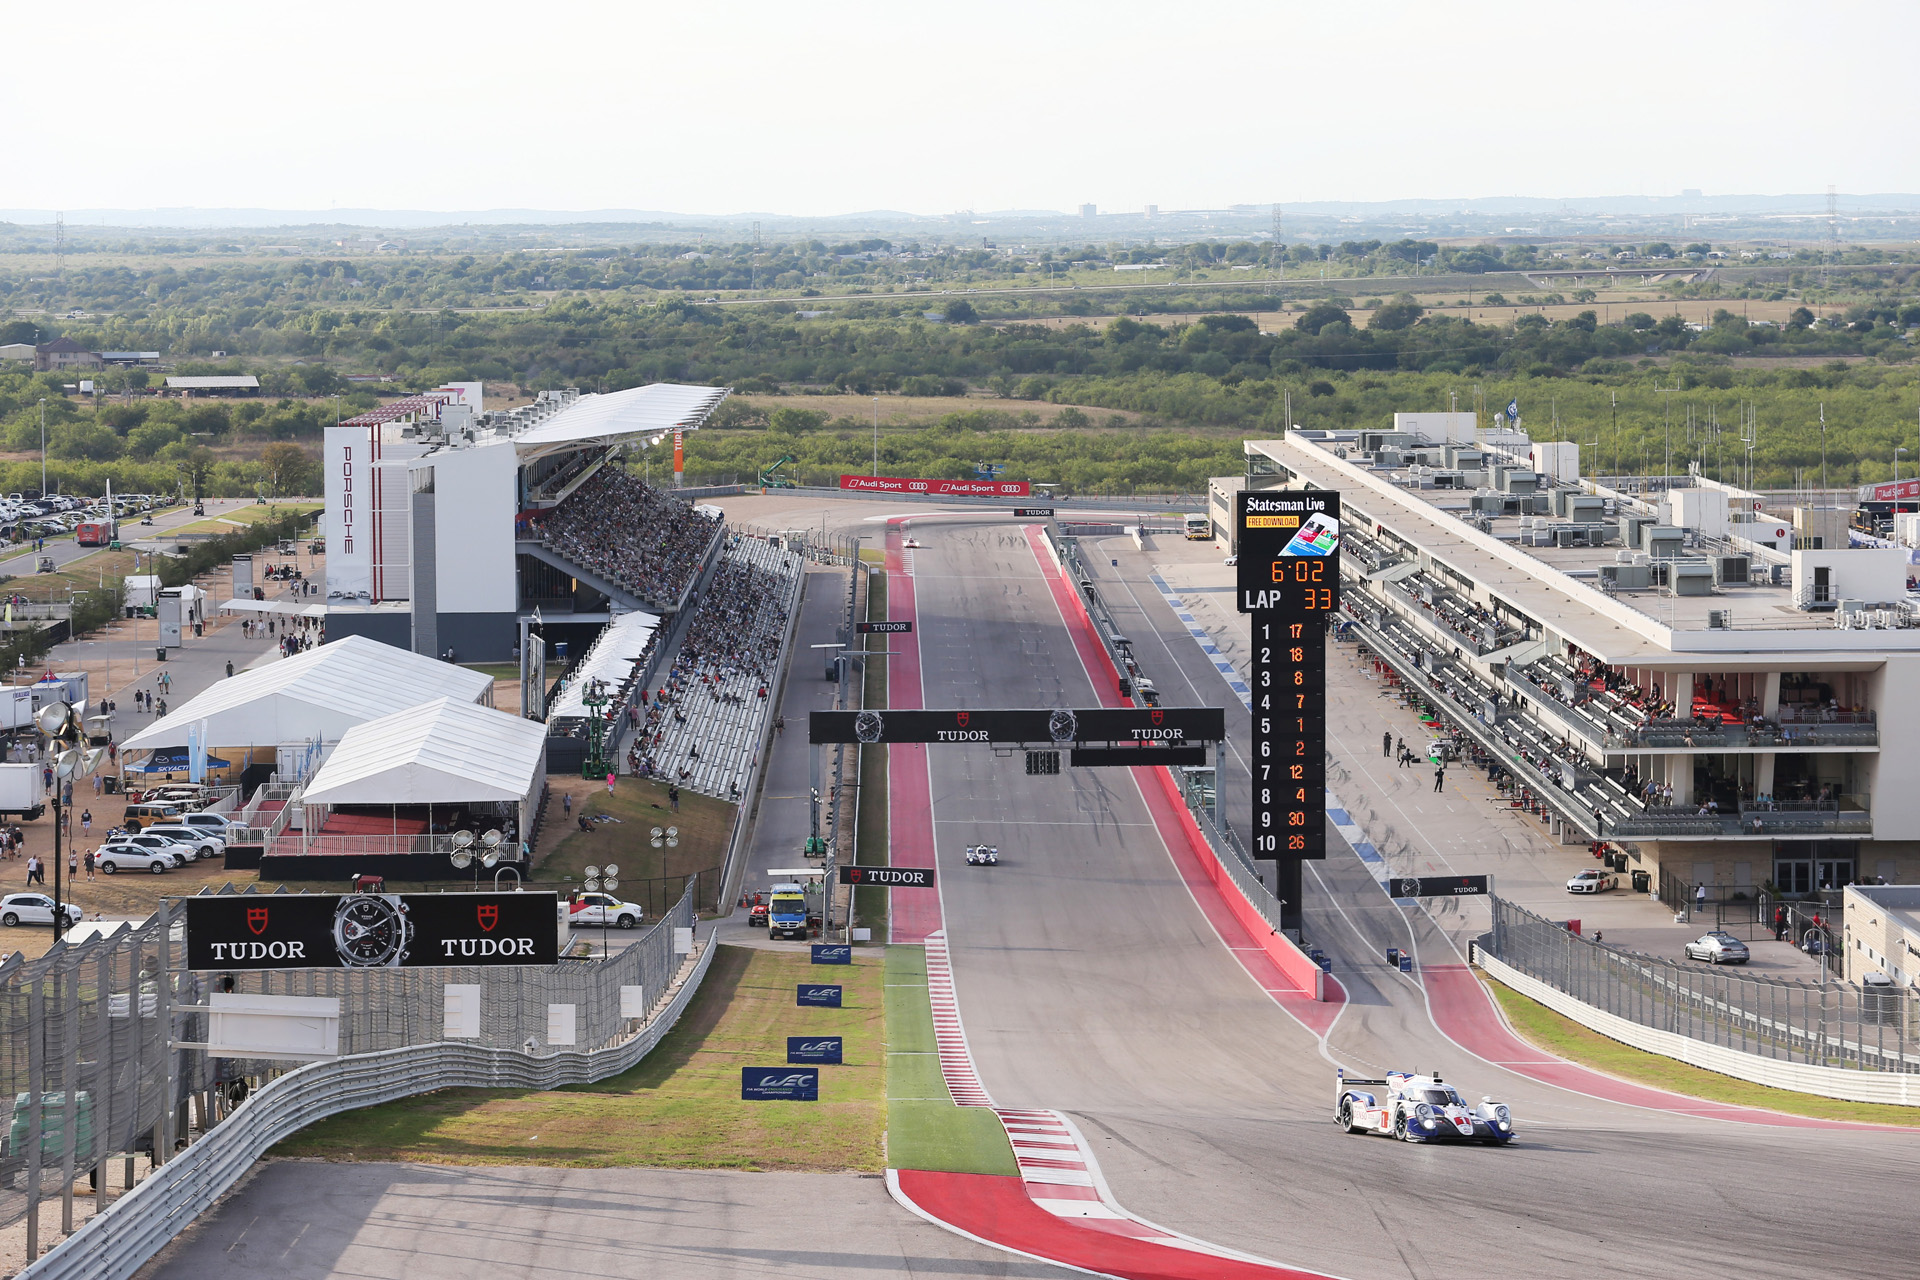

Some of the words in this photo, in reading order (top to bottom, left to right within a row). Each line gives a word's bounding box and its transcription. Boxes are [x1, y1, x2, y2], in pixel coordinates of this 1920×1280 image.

[859, 480, 877, 488] Audi
[879, 481, 902, 489] Sport
[971, 485, 994, 493] Sport
[1892, 487, 1905, 497] Sort
[343, 446, 353, 554] PORSCHE
[1246, 497, 1304, 513] Statesman
[1306, 497, 1325, 511] Live
[1248, 518, 1262, 526] FREE
[1263, 518, 1297, 526] DOWNLOAD
[1245, 590, 1281, 609] LAP
[1304, 588, 1331, 609] 33
[873, 623, 906, 631] TUDOR
[1262, 624, 1269, 640] 1
[1289, 623, 1303, 639] 17
[1261, 647, 1271, 663] 2
[1289, 647, 1303, 662] 18
[1261, 671, 1271, 687] 3
[1294, 671, 1303, 685] 8
[1261, 694, 1271, 710] 4
[1296, 694, 1305, 709] 7
[1131, 728, 1183, 740] TUDOR
[1261, 718, 1271, 734] 5
[1297, 718, 1303, 733] 1
[937, 730, 989, 741] TUDOR
[1261, 741, 1271, 757] 6
[1296, 741, 1305, 756] 2
[157, 764, 190, 773] SKYACTI
[1261, 764, 1271, 780] 7
[1289, 764, 1303, 779] 12
[1261, 788, 1271, 804] 8
[1296, 788, 1305, 802] 4
[1261, 812, 1271, 828] 9
[1288, 812, 1305, 826] 30
[1257, 835, 1276, 851] 10
[1288, 835, 1305, 850] 26
[868, 870, 925, 884] TUDOR
[211, 941, 306, 960] TUDOR
[441, 938, 536, 957] TUDOR
[808, 988, 839, 997] WEC
[800, 1041, 839, 1051] WEC
[760, 1074, 814, 1088] WEC
